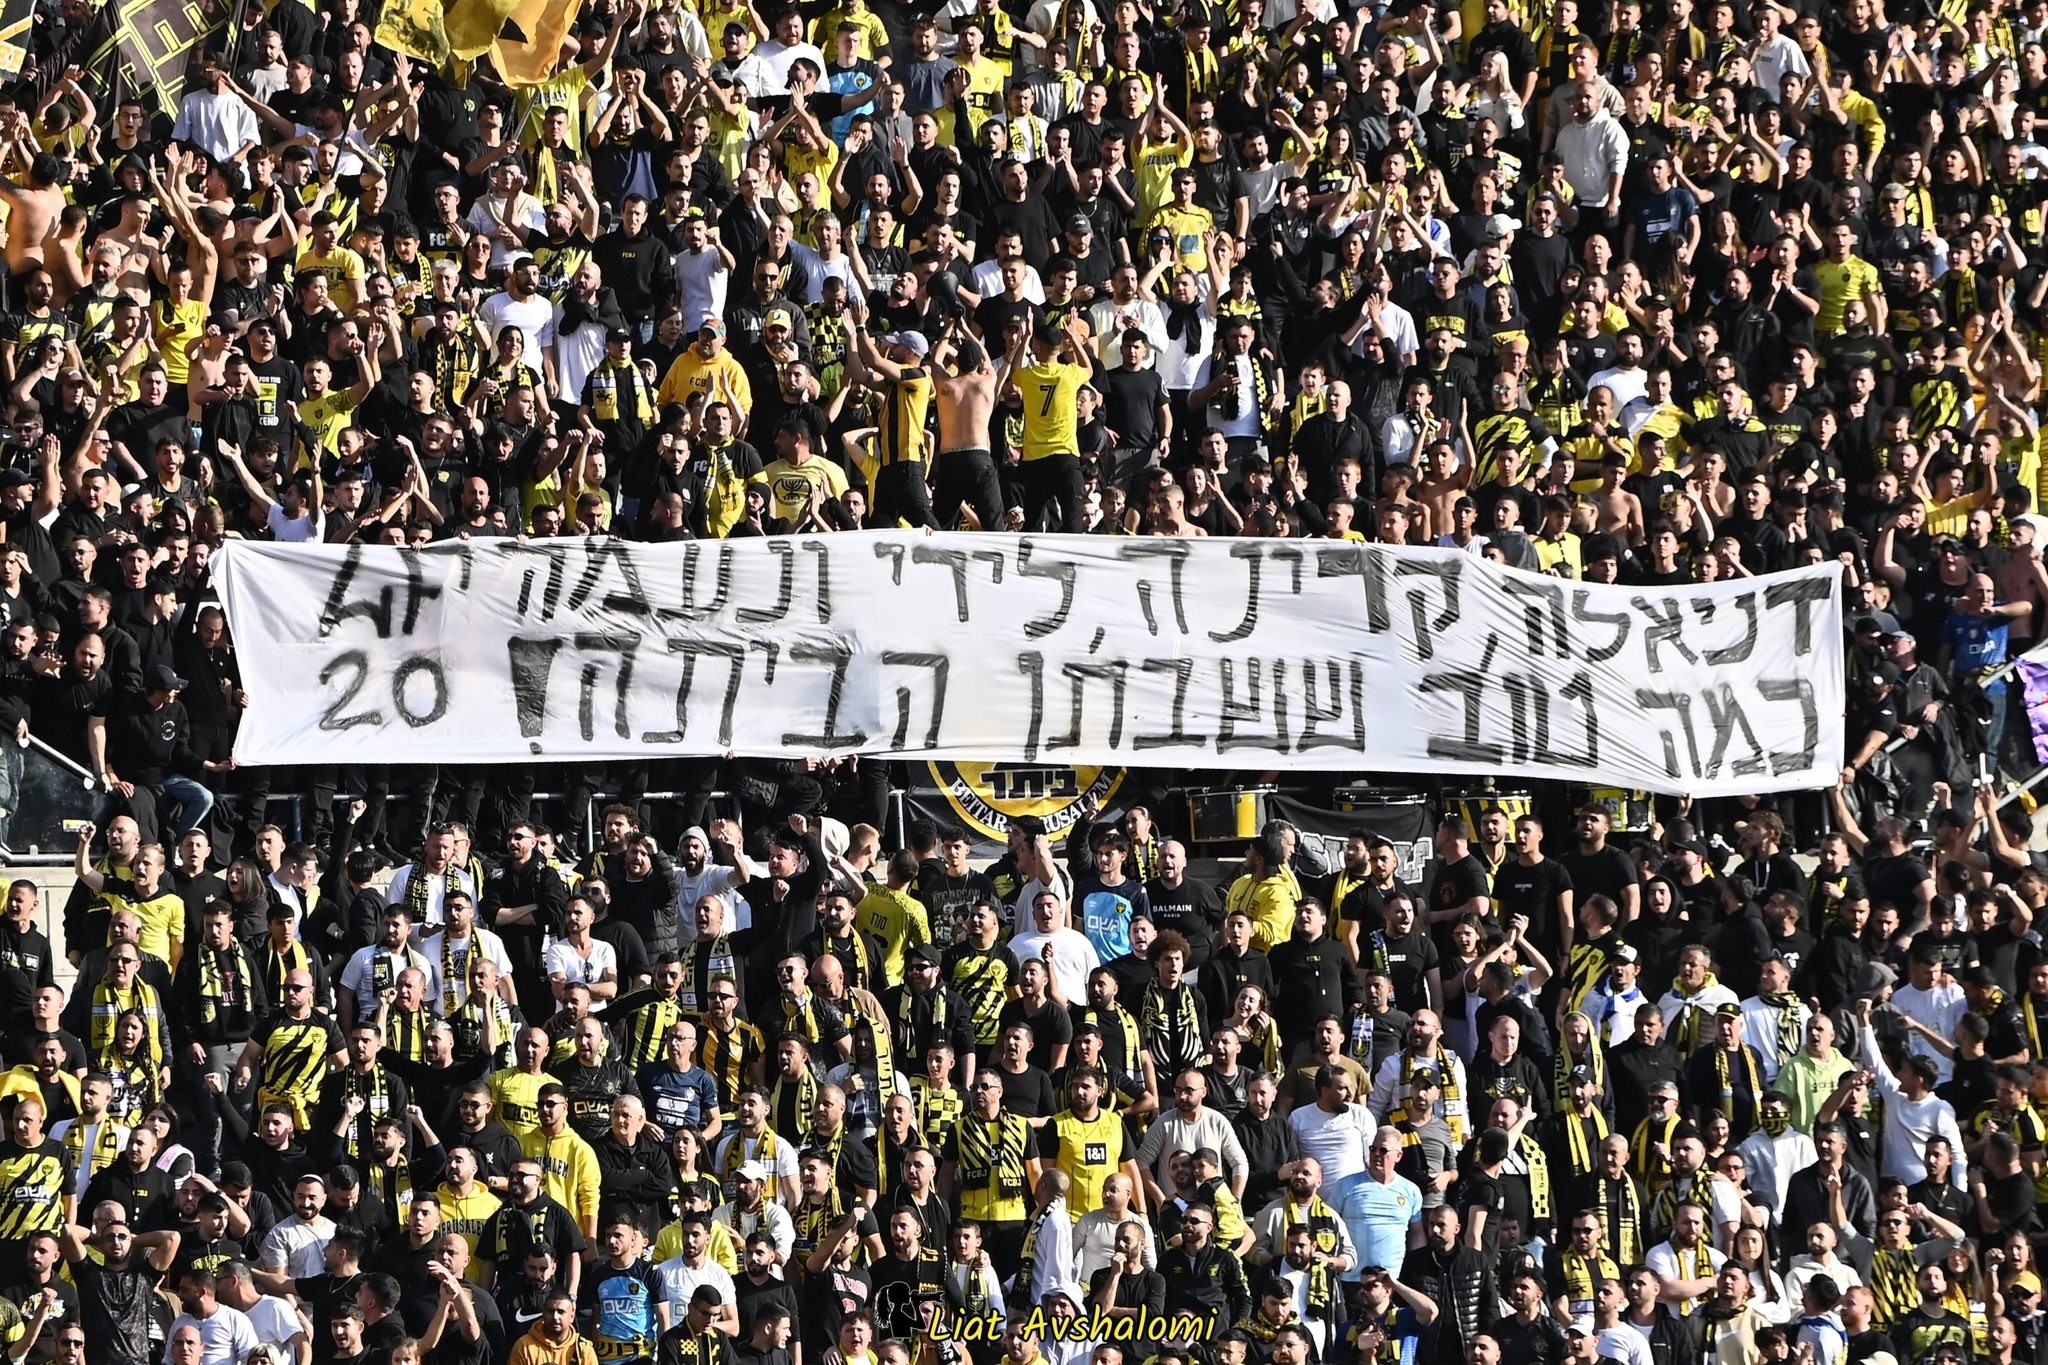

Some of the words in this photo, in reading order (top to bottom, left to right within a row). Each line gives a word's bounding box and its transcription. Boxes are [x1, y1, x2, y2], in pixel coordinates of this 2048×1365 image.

[1040, 385, 1056, 416] 7
[497, 536, 831, 624] ונעמה
[319, 649, 449, 731] 20
[1018, 651, 1365, 761] ששבתן
[1419, 668, 1598, 768] טוב
[1636, 678, 1818, 779] כמה
[950, 777, 1008, 833] BEITAR
[981, 770, 1079, 799] ביתר
[1152, 904, 1192, 912] BALMAIN
[967, 1169, 987, 1180] FCBJ
[1086, 1147, 1105, 1160] 1&1
[1003, 1178, 1021, 1187] FCBJ
